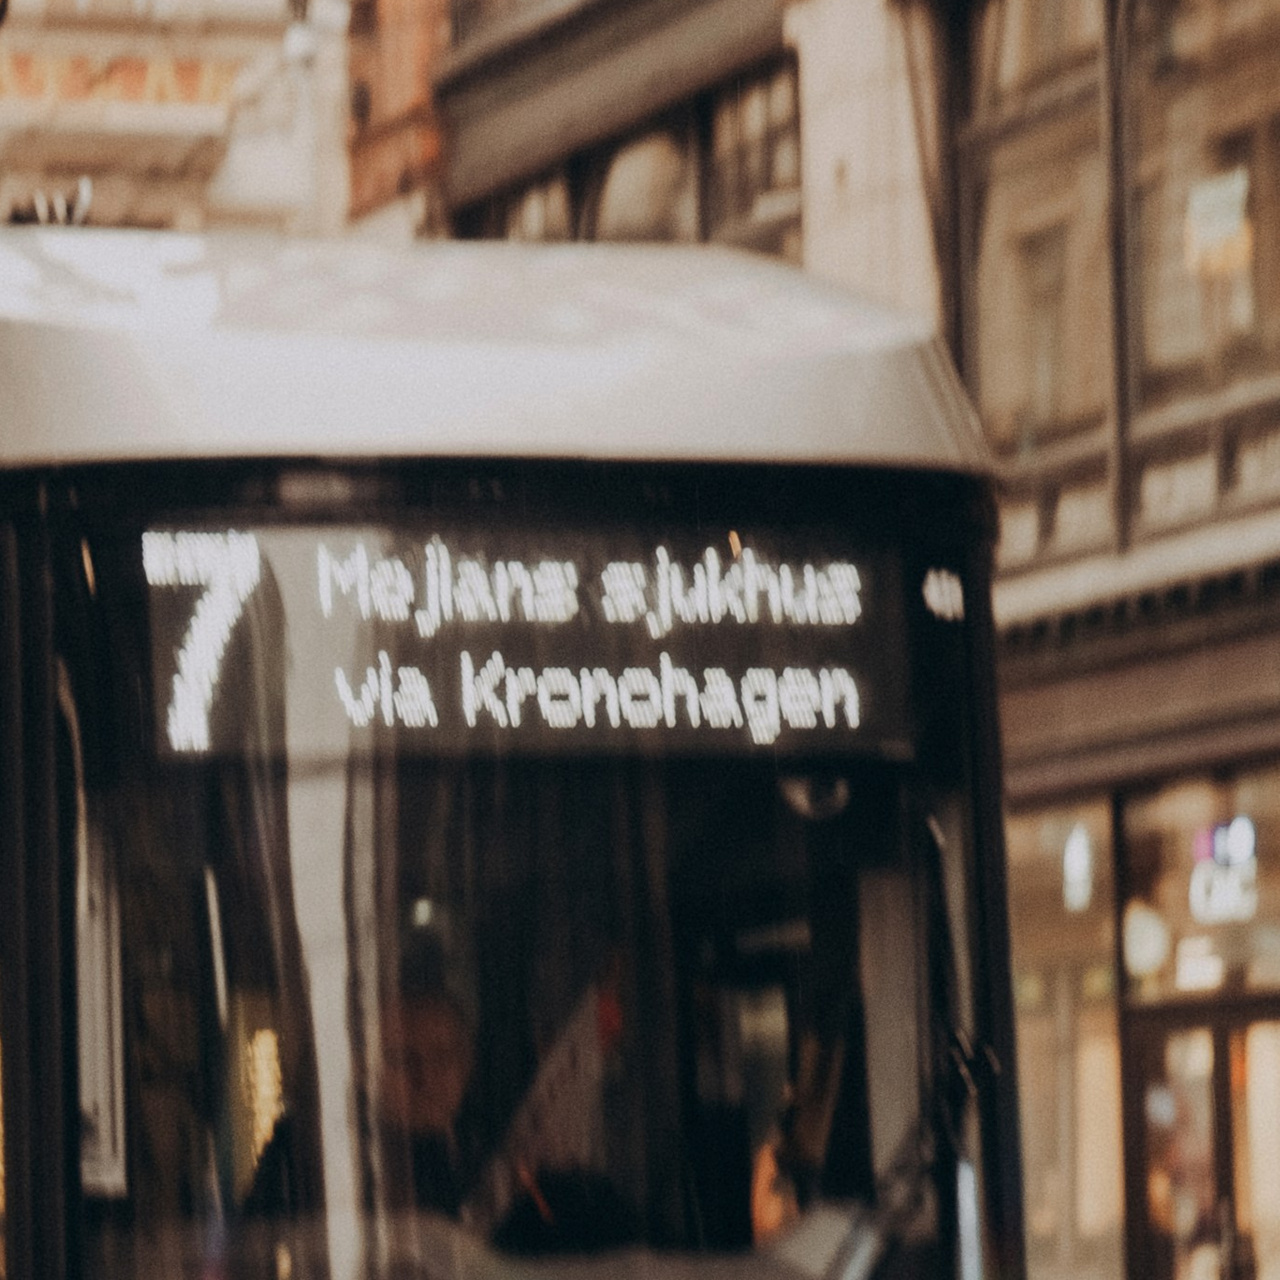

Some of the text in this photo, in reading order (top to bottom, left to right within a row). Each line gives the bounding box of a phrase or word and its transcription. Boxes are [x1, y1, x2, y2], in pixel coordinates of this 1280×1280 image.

[316, 538, 862, 639] Mejlans sjukhus
[141, 531, 261, 751] 7
[334, 650, 860, 744] via Kronohagen
